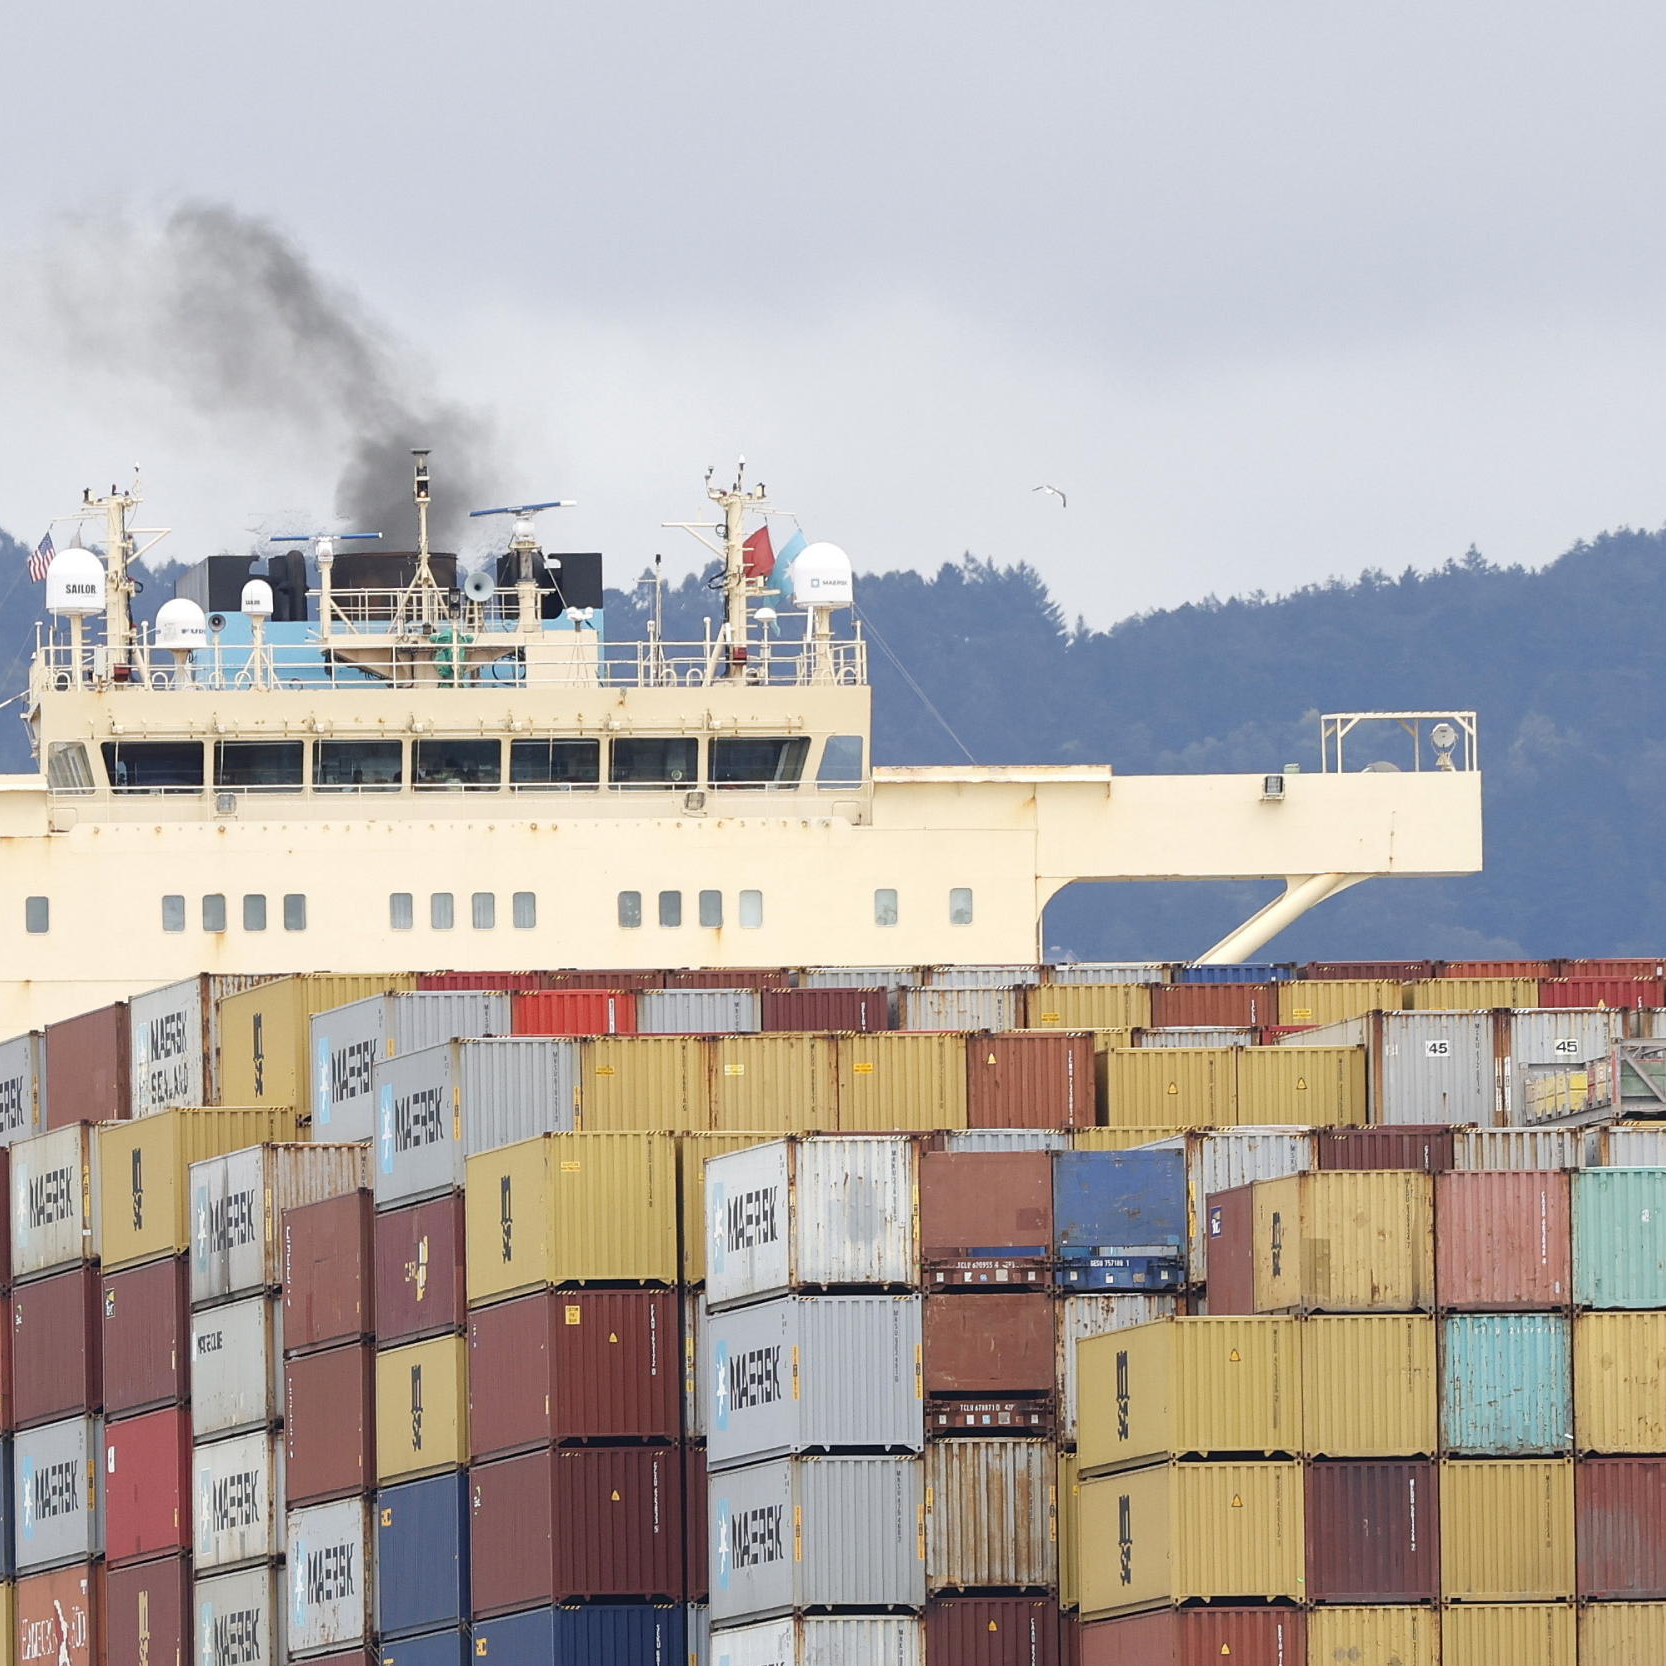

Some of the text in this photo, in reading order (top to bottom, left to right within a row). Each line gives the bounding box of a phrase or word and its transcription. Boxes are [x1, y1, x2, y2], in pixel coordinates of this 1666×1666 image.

[65, 584, 96, 594] SAILOR
[151, 1011, 186, 1062] MAERSK
[1429, 1043, 1447, 1053] 45
[1556, 1041, 1577, 1052] 45
[395, 1087, 443, 1152] MAERSK
[30, 1166, 73, 1228] MAERSK
[210, 1189, 255, 1255] MAERSK
[728, 1186, 778, 1252] MAERSK
[730, 1345, 781, 1411] MAERSK
[36, 1460, 78, 1520] MAERSK
[213, 1470, 259, 1531] MAERSK
[732, 1505, 783, 1569] MAERSK
[308, 1543, 354, 1605] MAERSK
